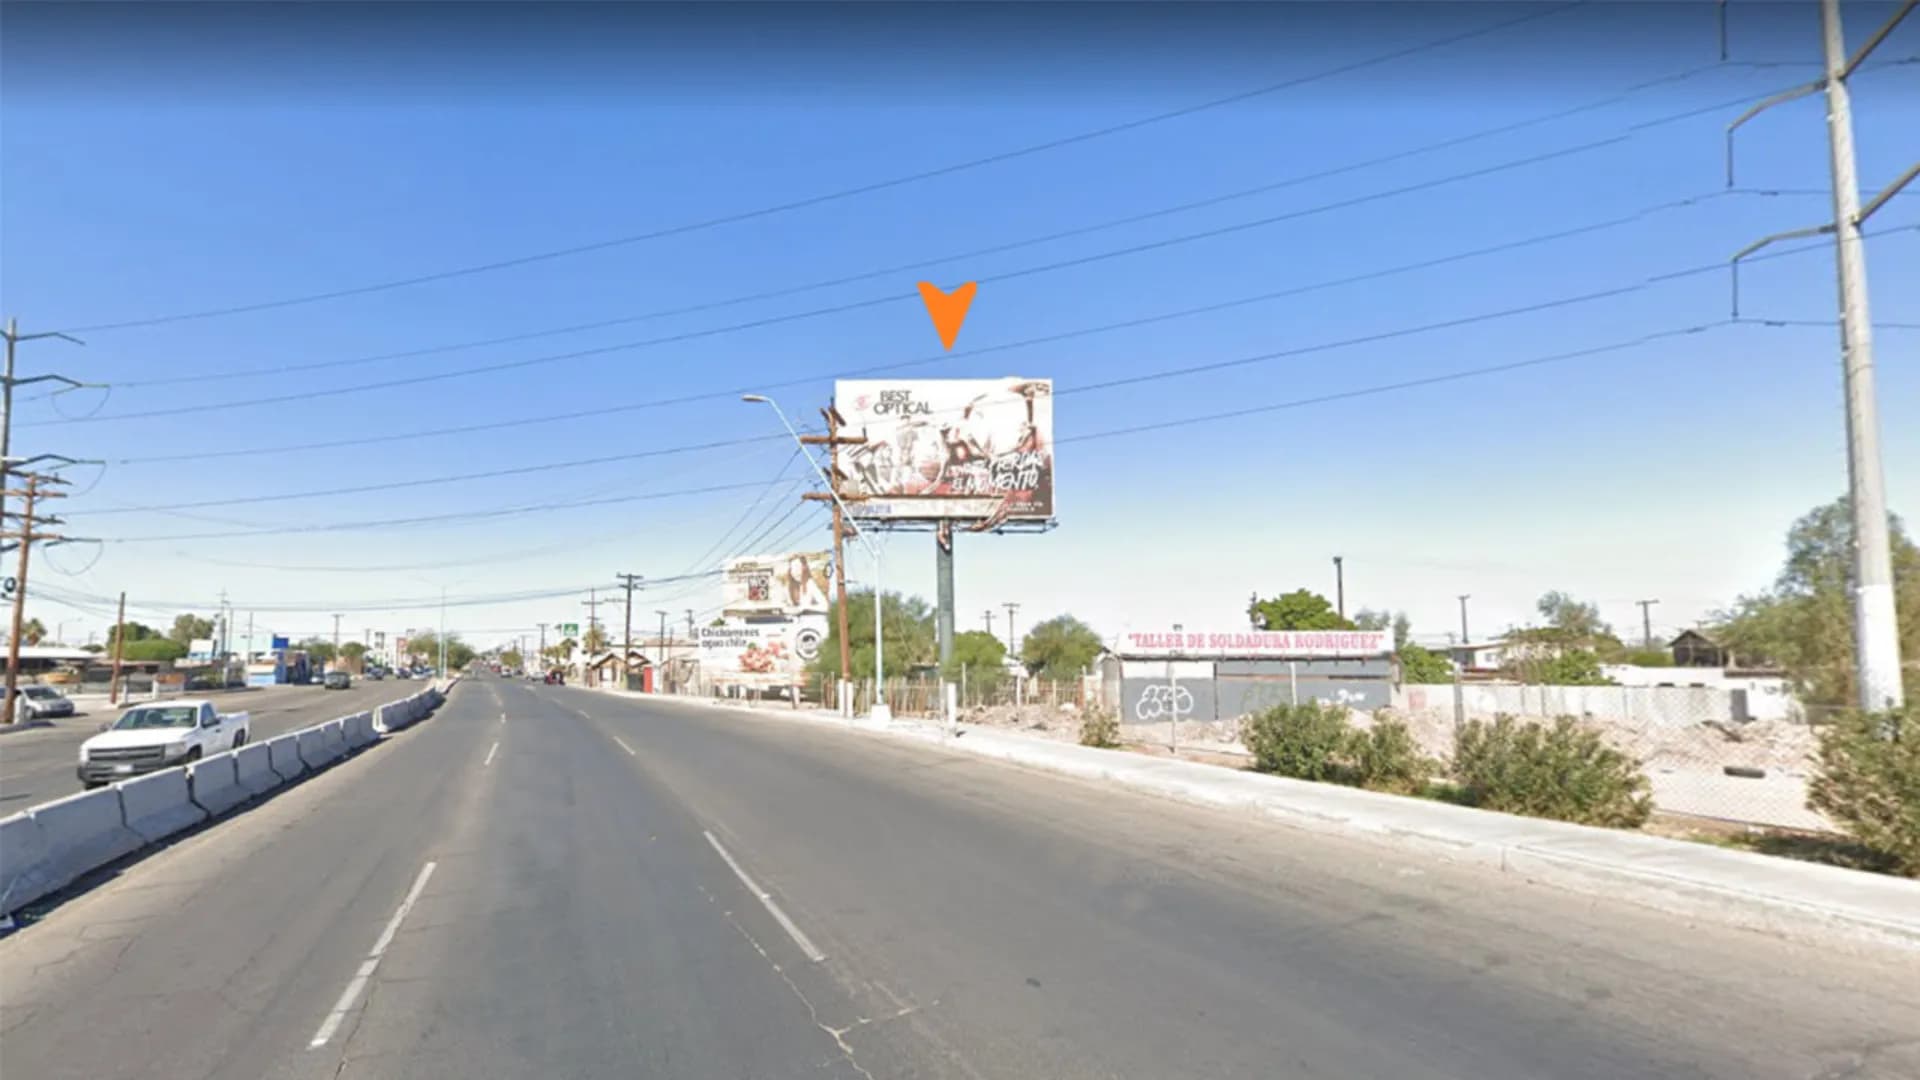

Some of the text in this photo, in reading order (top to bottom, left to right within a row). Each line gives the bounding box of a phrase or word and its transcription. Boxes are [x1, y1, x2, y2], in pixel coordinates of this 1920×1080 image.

[880, 390, 912, 401] BEST
[873, 401, 934, 415] OPTICAL
[1187, 633, 1205, 648] DE
[1208, 633, 1290, 648] SOLDADURA
